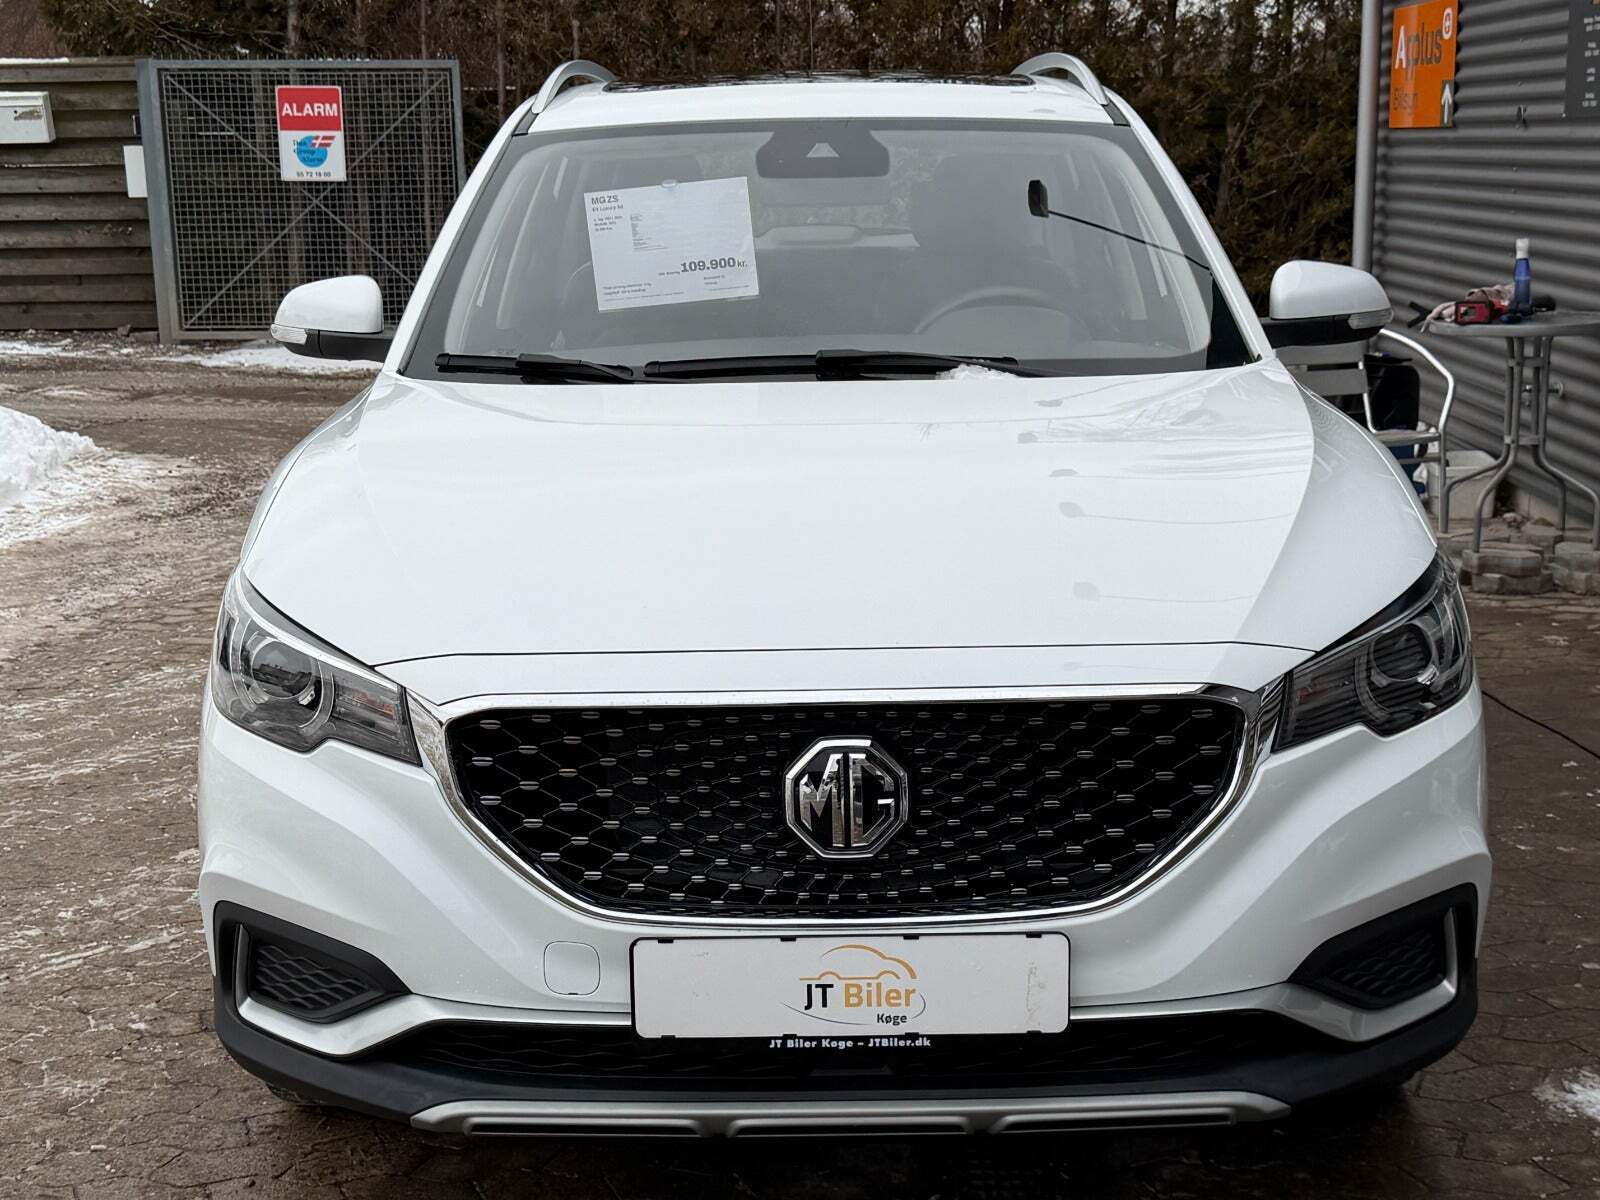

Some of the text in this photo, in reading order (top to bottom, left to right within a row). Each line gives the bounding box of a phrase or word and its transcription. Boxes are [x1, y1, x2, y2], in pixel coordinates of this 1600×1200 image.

[281, 102, 338, 117] ALARM
[591, 194, 619, 205] MG ZS
[680, 257, 747, 273] 109.900 kr.
[800, 753, 894, 847] MG
[804, 982, 916, 1010] JT Biler
[877, 1013, 907, 1026] Køge
[769, 1039, 783, 1048] JT
[786, 1038, 817, 1048] Biler
[868, 1036, 931, 1047] JTBiler.dk
